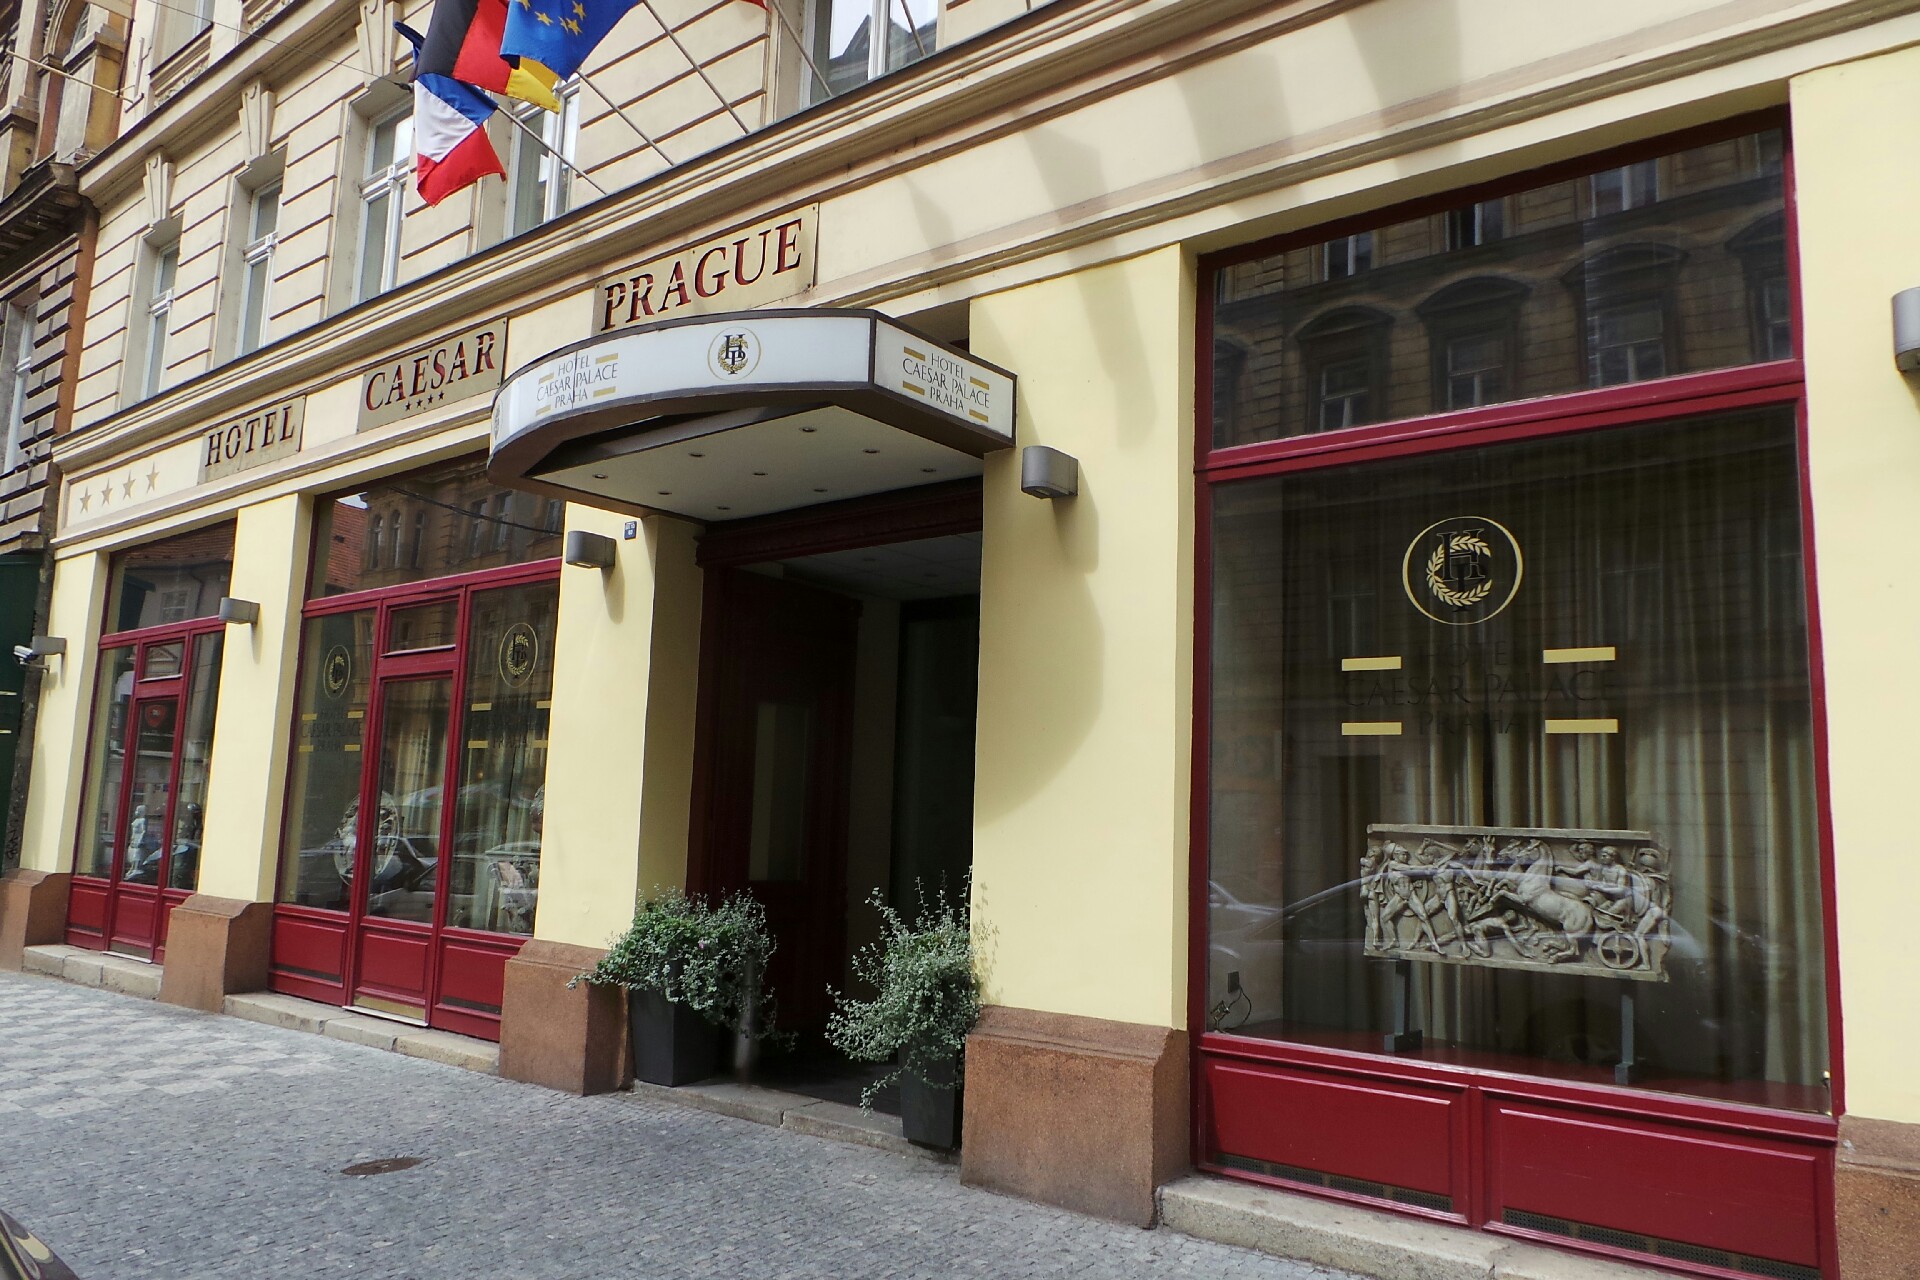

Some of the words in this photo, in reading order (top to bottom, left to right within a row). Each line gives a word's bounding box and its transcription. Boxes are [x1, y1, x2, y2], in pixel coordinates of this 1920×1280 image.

[205, 404, 296, 468] HOTEL
[365, 331, 495, 411] CAESAR
[601, 218, 802, 331] PRAGUE
[558, 354, 590, 376] HOTEL
[931, 352, 965, 380] HOTEL
[536, 376, 571, 402] CAESAR
[576, 362, 618, 387] PALACE
[902, 358, 948, 391] CAESAR
[952, 379, 990, 409] PALACE
[554, 388, 588, 408] PRAHA
[930, 386, 964, 412] PRAHA
[1343, 674, 1471, 707] CAESAR
